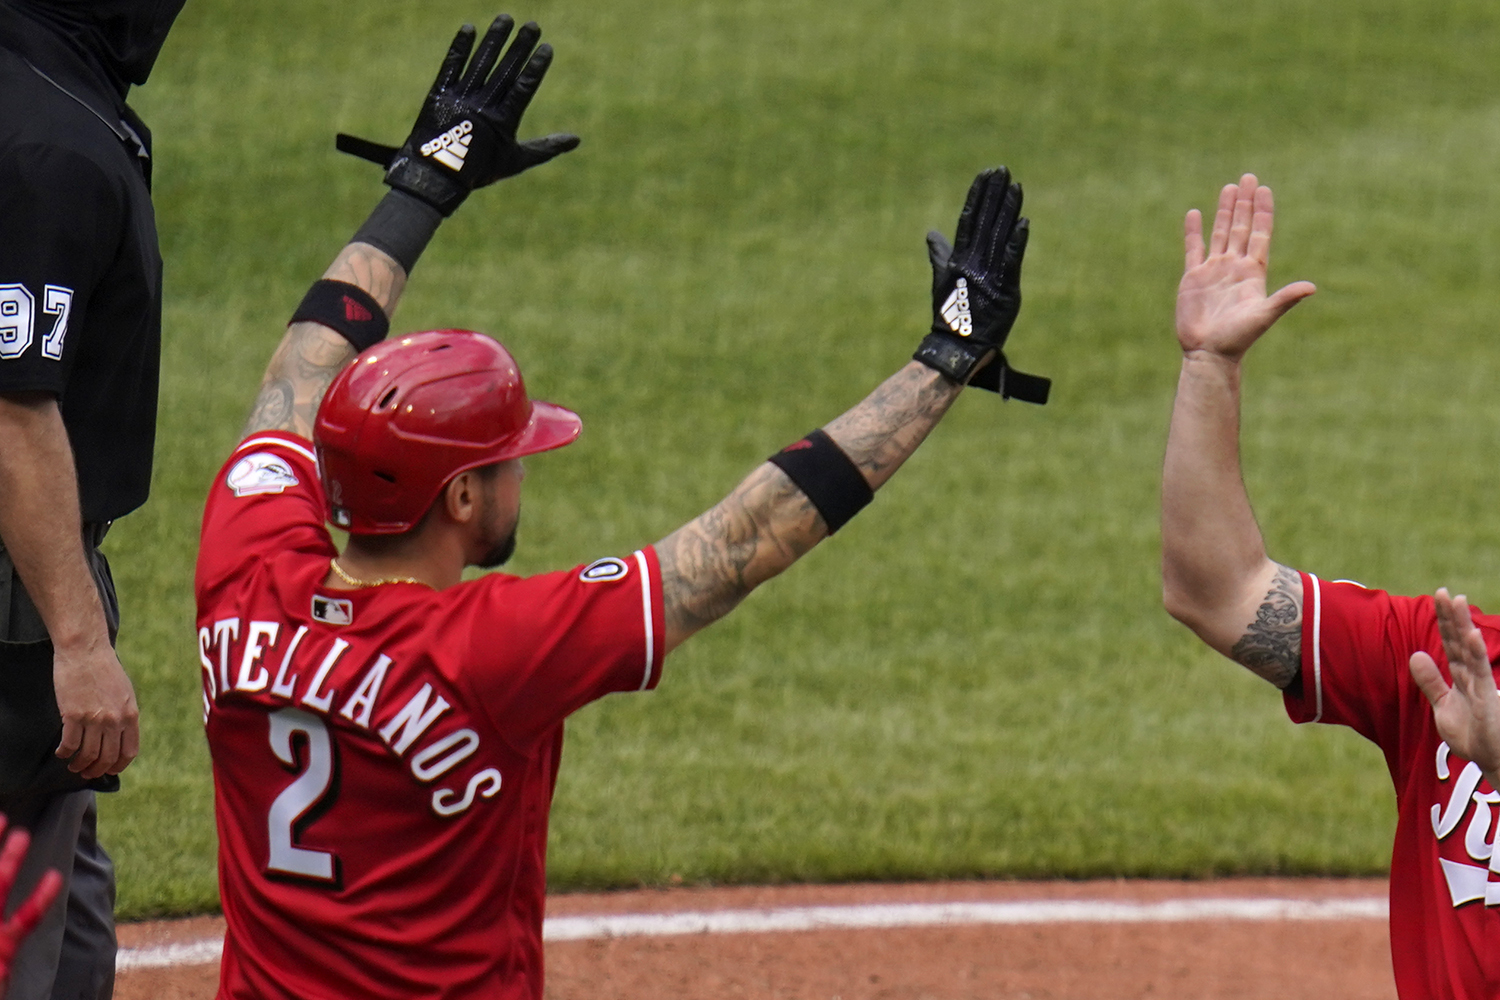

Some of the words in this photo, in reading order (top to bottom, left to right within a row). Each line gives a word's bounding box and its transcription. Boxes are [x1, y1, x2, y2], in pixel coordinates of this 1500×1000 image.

[420, 120, 474, 157] adidas
[0, 283, 75, 361] 97
[956, 277, 973, 337] adidas
[199, 617, 503, 818] STELLANOS
[267, 708, 341, 885] 2
